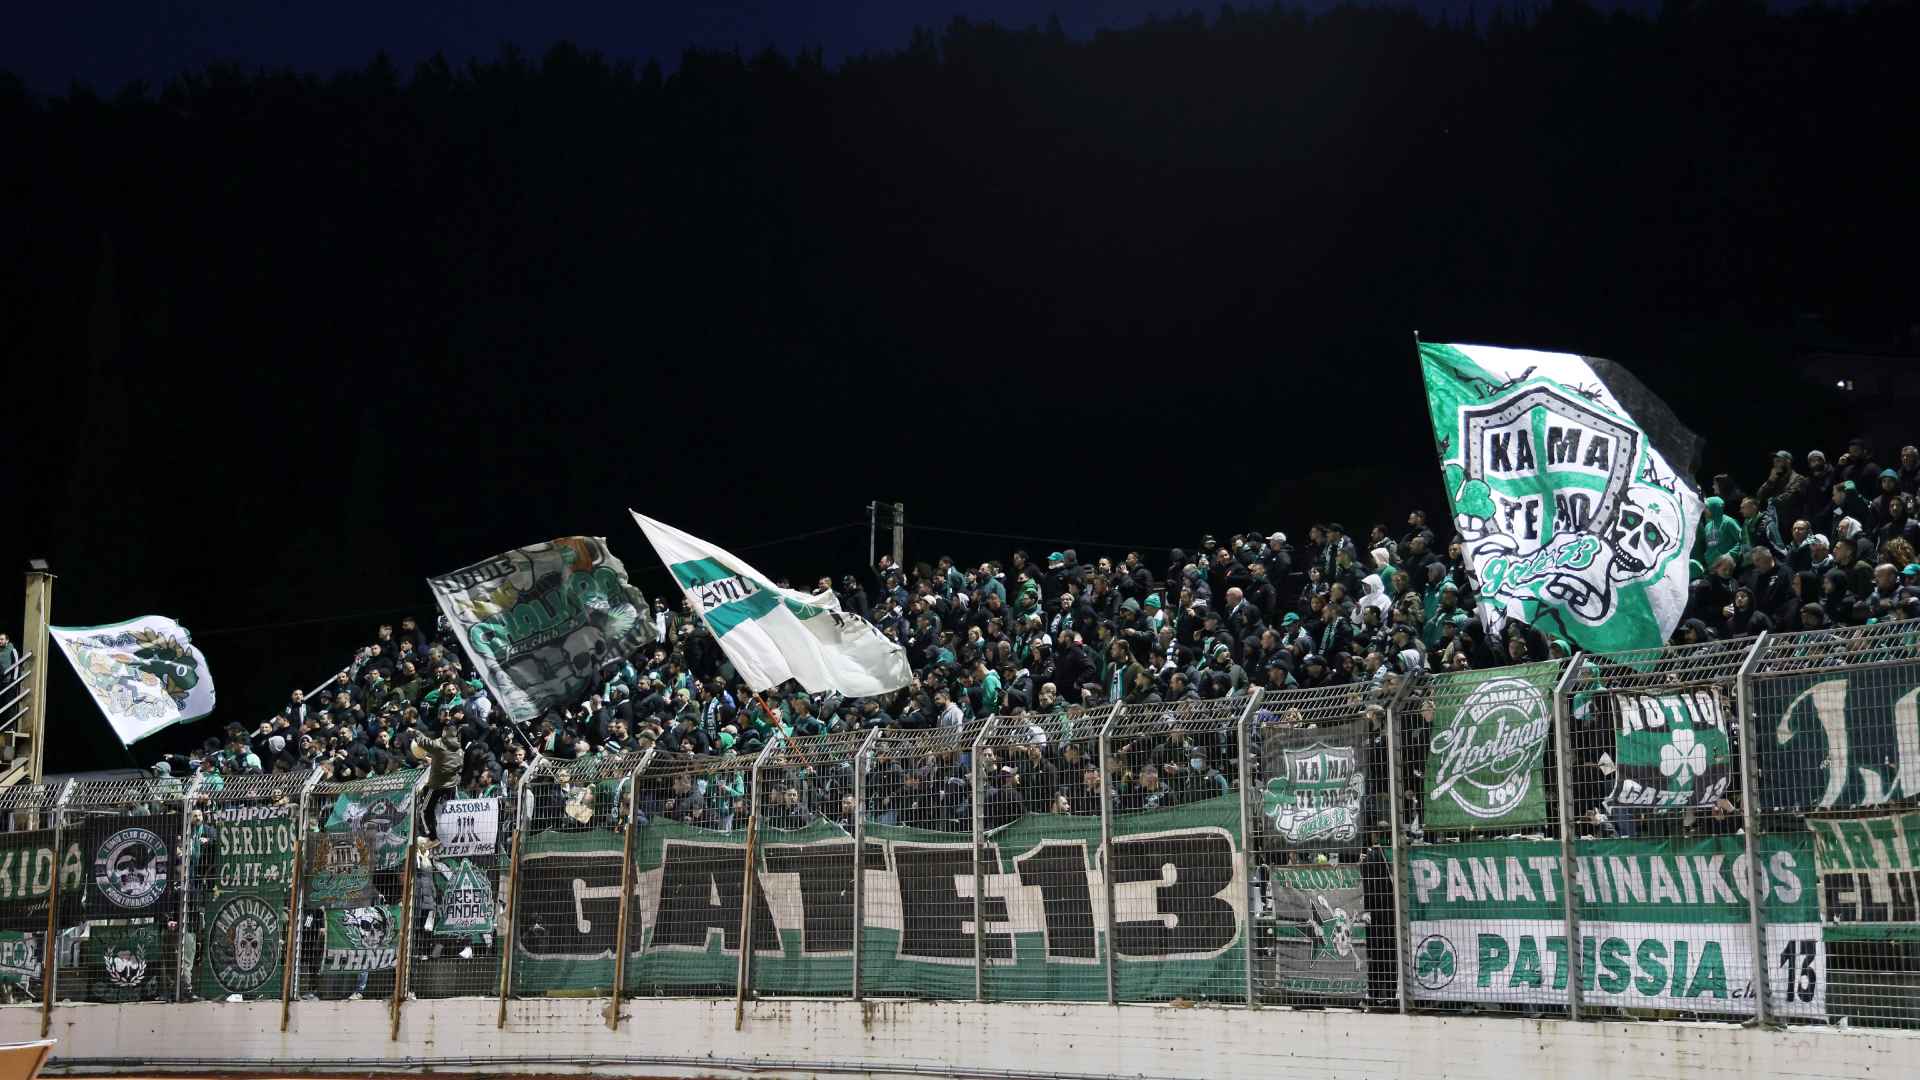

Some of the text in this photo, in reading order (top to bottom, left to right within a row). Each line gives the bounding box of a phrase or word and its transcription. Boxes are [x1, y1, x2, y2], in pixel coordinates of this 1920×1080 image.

[1618, 779, 1694, 805] GATE
[220, 823, 297, 856] SERIFOS
[220, 862, 262, 887] GATE
[518, 826, 1242, 966] GATE 13
[1411, 851, 1802, 904] PANATHINAIKOS
[1823, 873, 1920, 922] CLU
[1477, 932, 1729, 1000] PATISSIA
[1779, 939, 1819, 1003] 13
